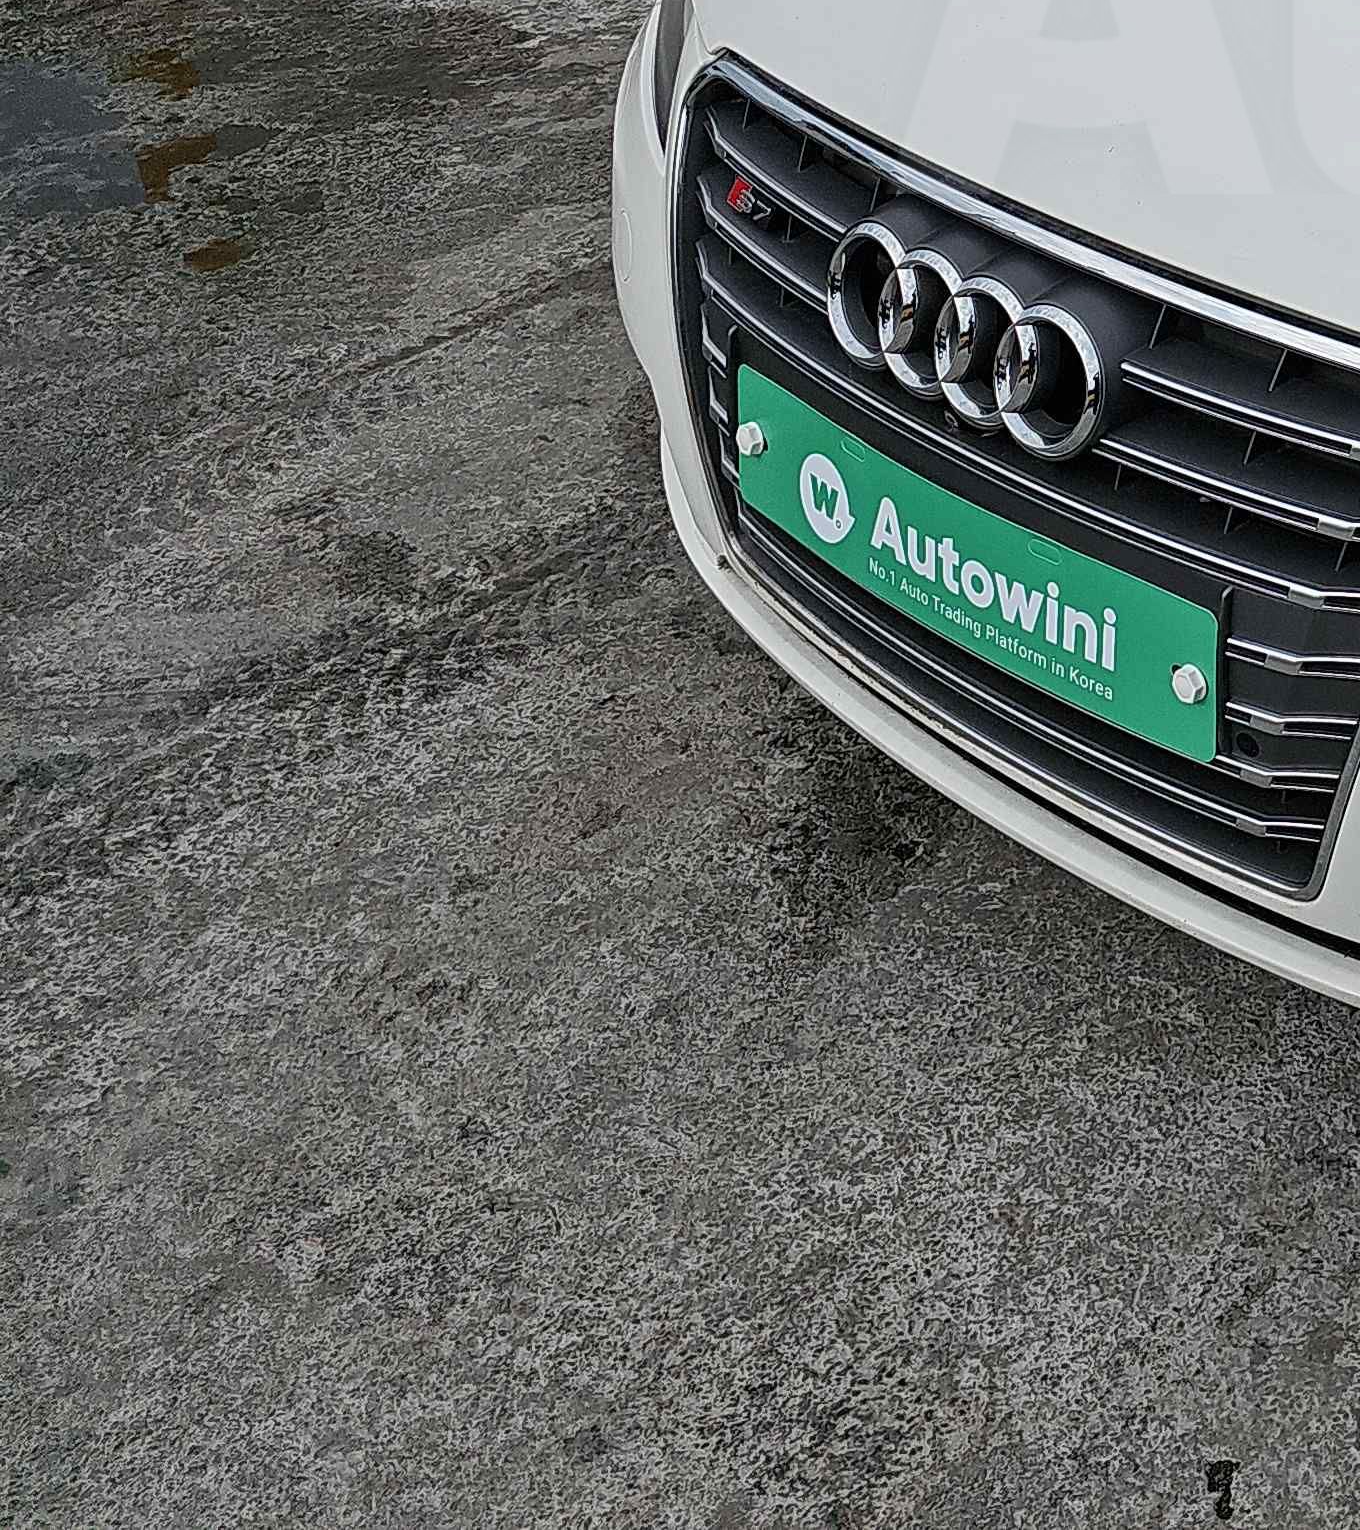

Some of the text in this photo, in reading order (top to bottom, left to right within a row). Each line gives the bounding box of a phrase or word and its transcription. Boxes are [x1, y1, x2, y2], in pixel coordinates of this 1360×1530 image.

[731, 181, 772, 221] S7
[868, 556, 1114, 702] No.1 Auto Trading Platform in Korea
[870, 495, 1117, 672] Autowini
